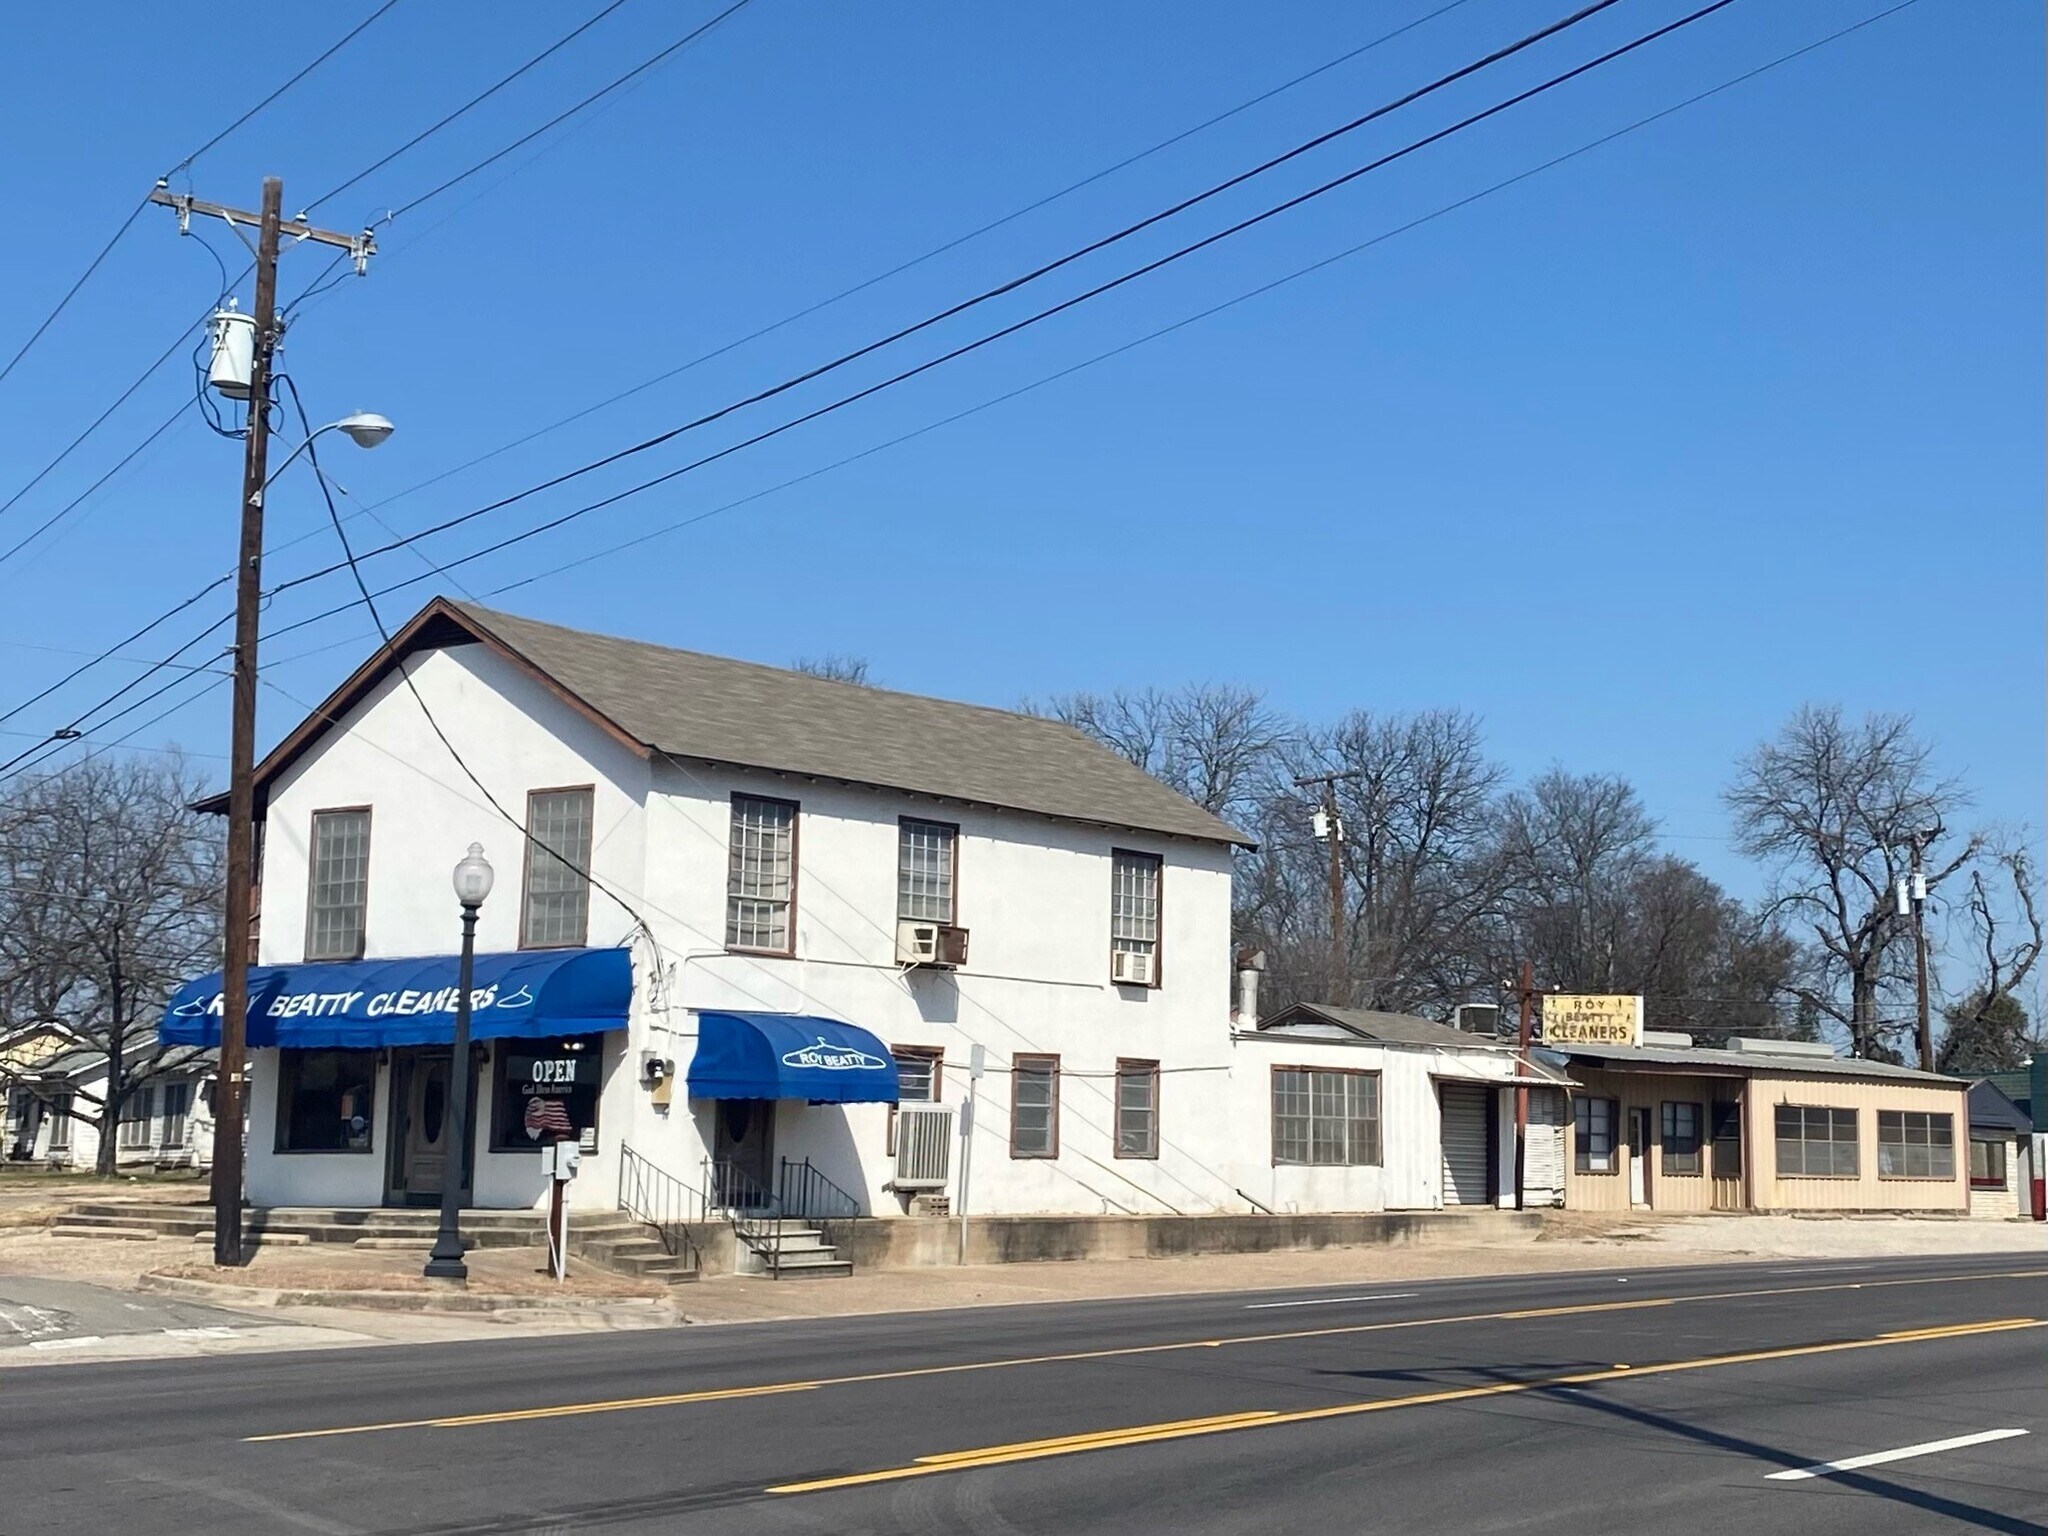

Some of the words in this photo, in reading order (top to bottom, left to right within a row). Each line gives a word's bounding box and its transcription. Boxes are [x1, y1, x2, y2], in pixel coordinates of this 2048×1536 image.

[206, 991, 264, 1017] RY
[266, 990, 364, 1018] BEATTY
[367, 984, 499, 1018] CLEANERS
[1574, 1000, 1606, 1010] ROY
[1565, 1012, 1614, 1023] BEATTY
[1551, 1026, 1627, 1039] CLEANERS
[800, 1051, 823, 1065] ROY
[824, 1053, 866, 1066] BEATTY
[532, 1059, 577, 1082] OPEN
